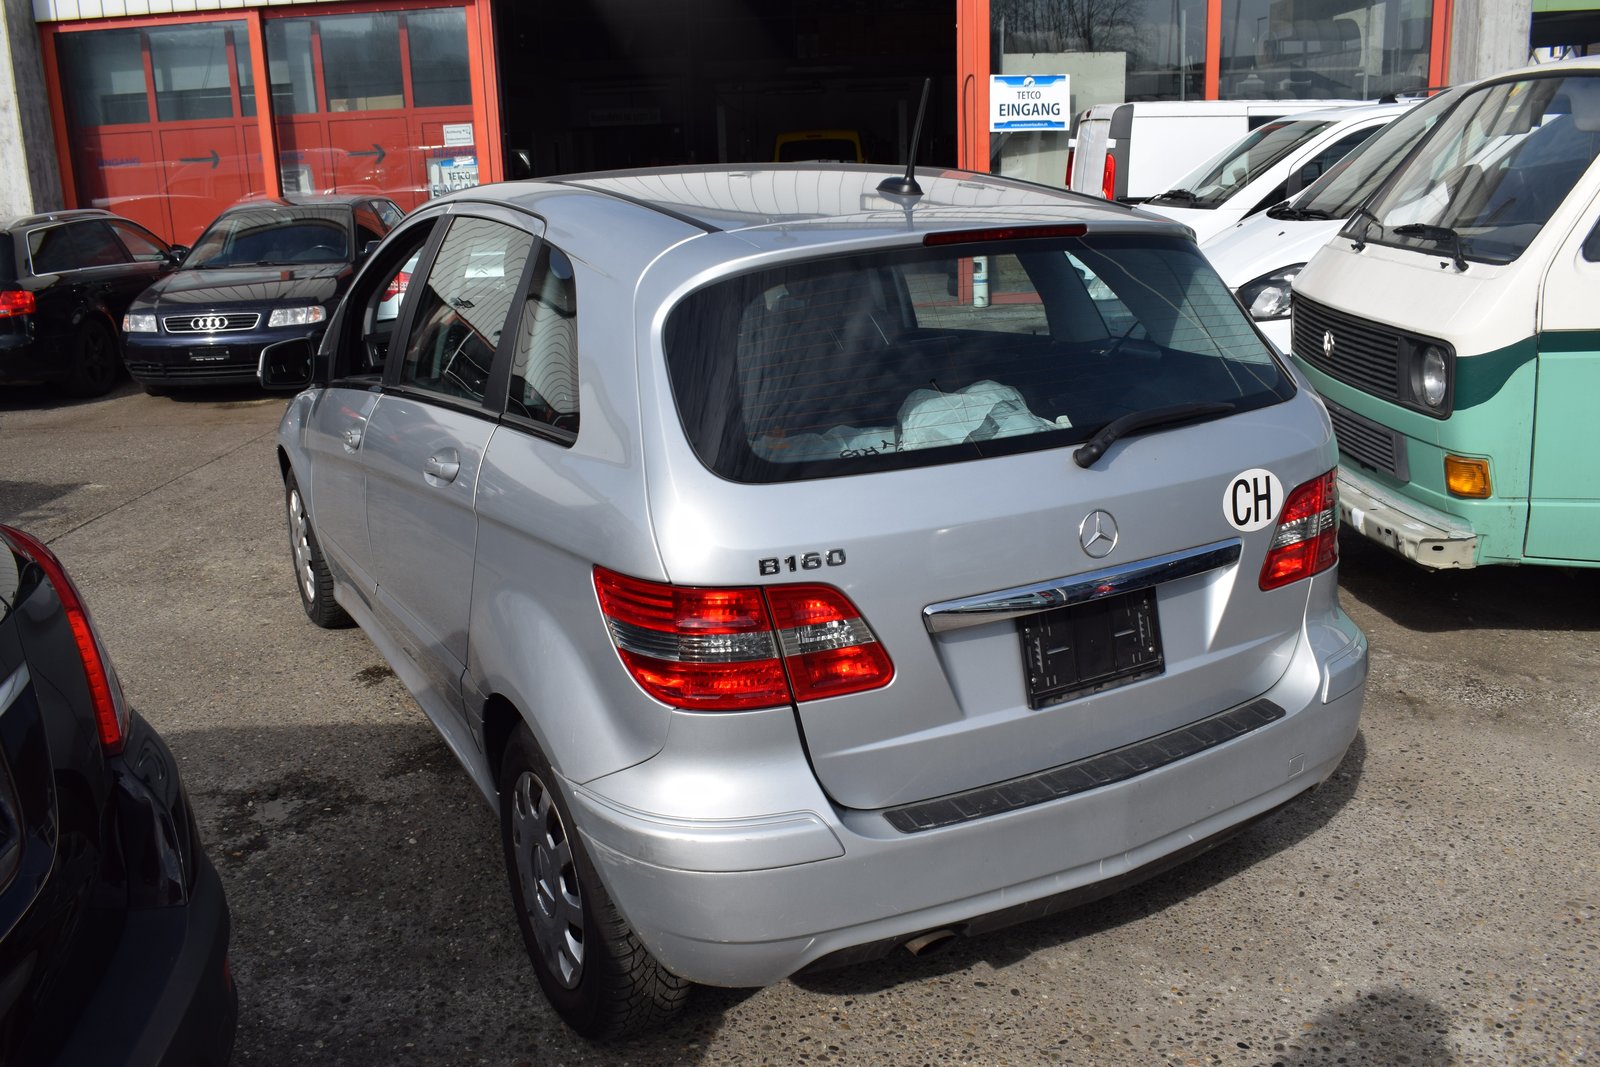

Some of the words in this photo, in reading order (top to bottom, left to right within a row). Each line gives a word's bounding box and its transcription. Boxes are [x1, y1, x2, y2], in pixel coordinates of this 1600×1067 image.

[1017, 91, 1041, 99] TETCO
[999, 103, 1060, 116] EINGANG
[448, 172, 470, 180] TETCO
[1231, 475, 1272, 526] CH
[759, 548, 847, 577] B160
